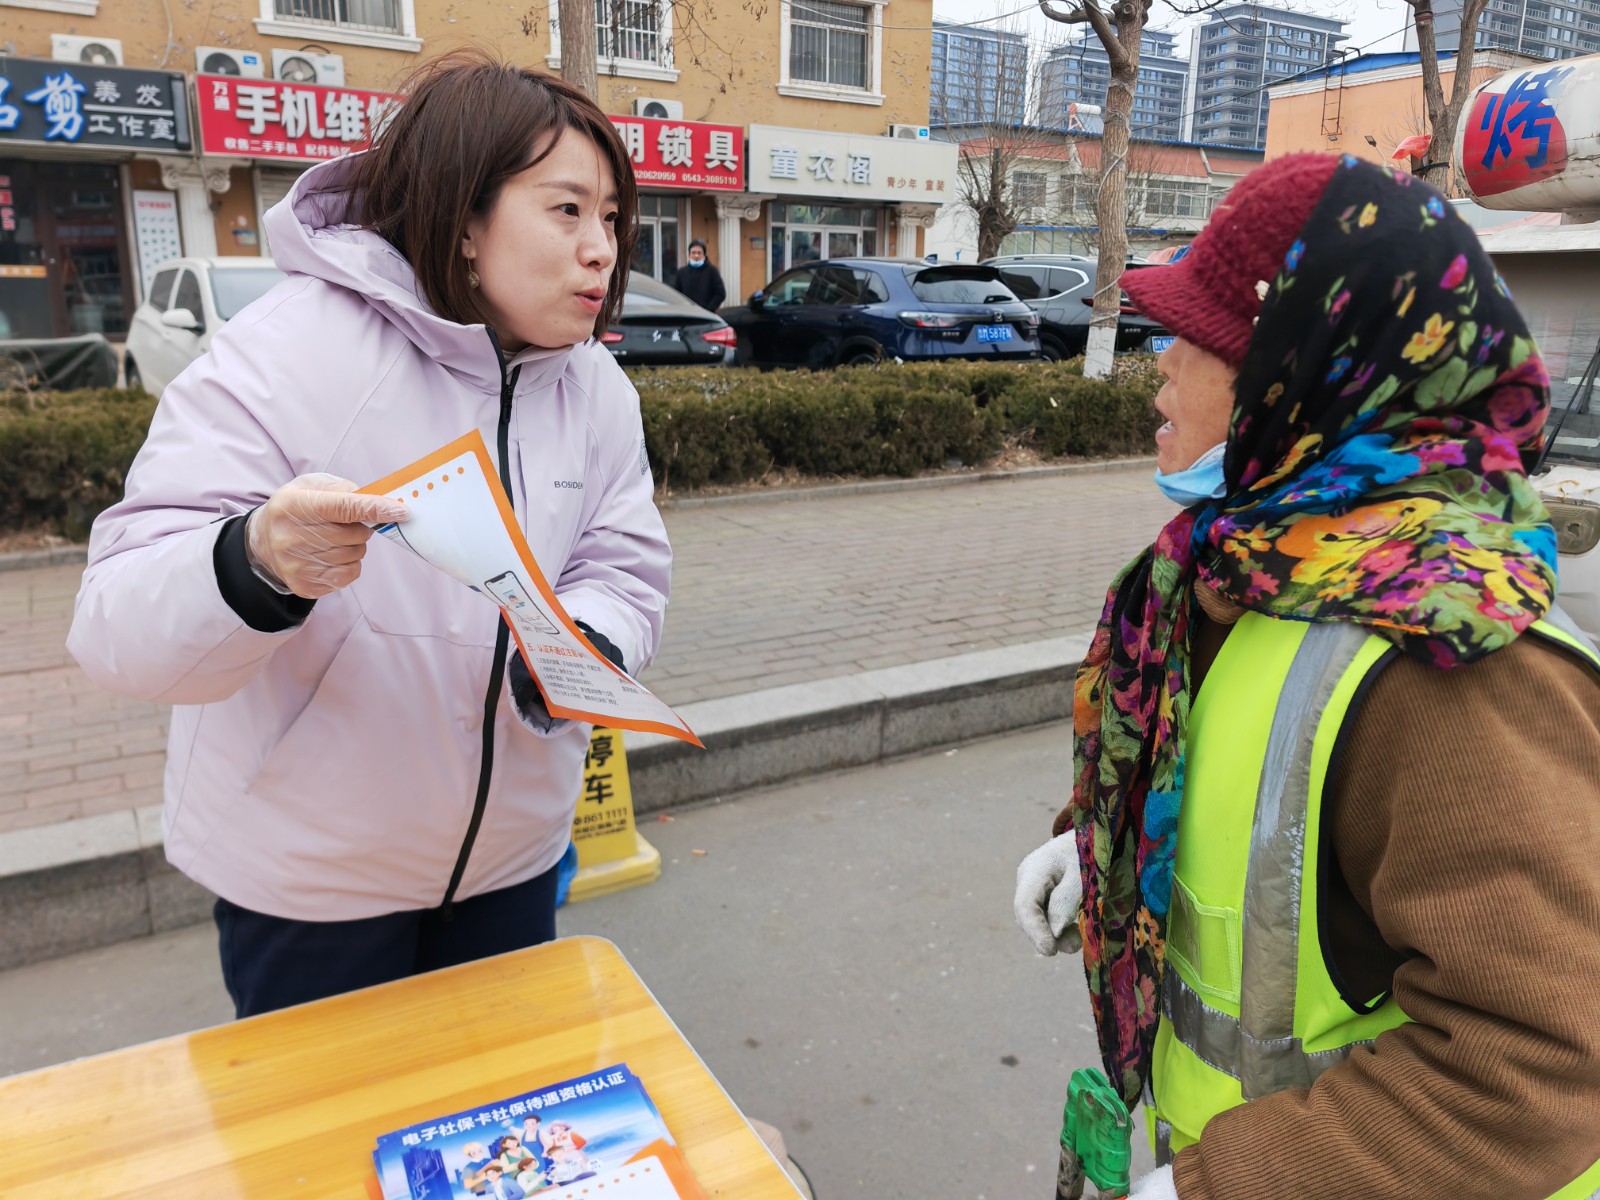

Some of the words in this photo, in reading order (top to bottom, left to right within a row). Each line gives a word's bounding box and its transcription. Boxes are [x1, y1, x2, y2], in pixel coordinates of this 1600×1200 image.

[93, 79, 163, 107] 美发
[88, 114, 175, 141] 工作室
[1480, 66, 1576, 170] 烤
[611, 121, 739, 171] 明锁具
[769, 145, 874, 185] 童衣阁
[887, 176, 918, 190] 青少年
[402, 1070, 626, 1147] 电子社保卡社保待遇资格认证
